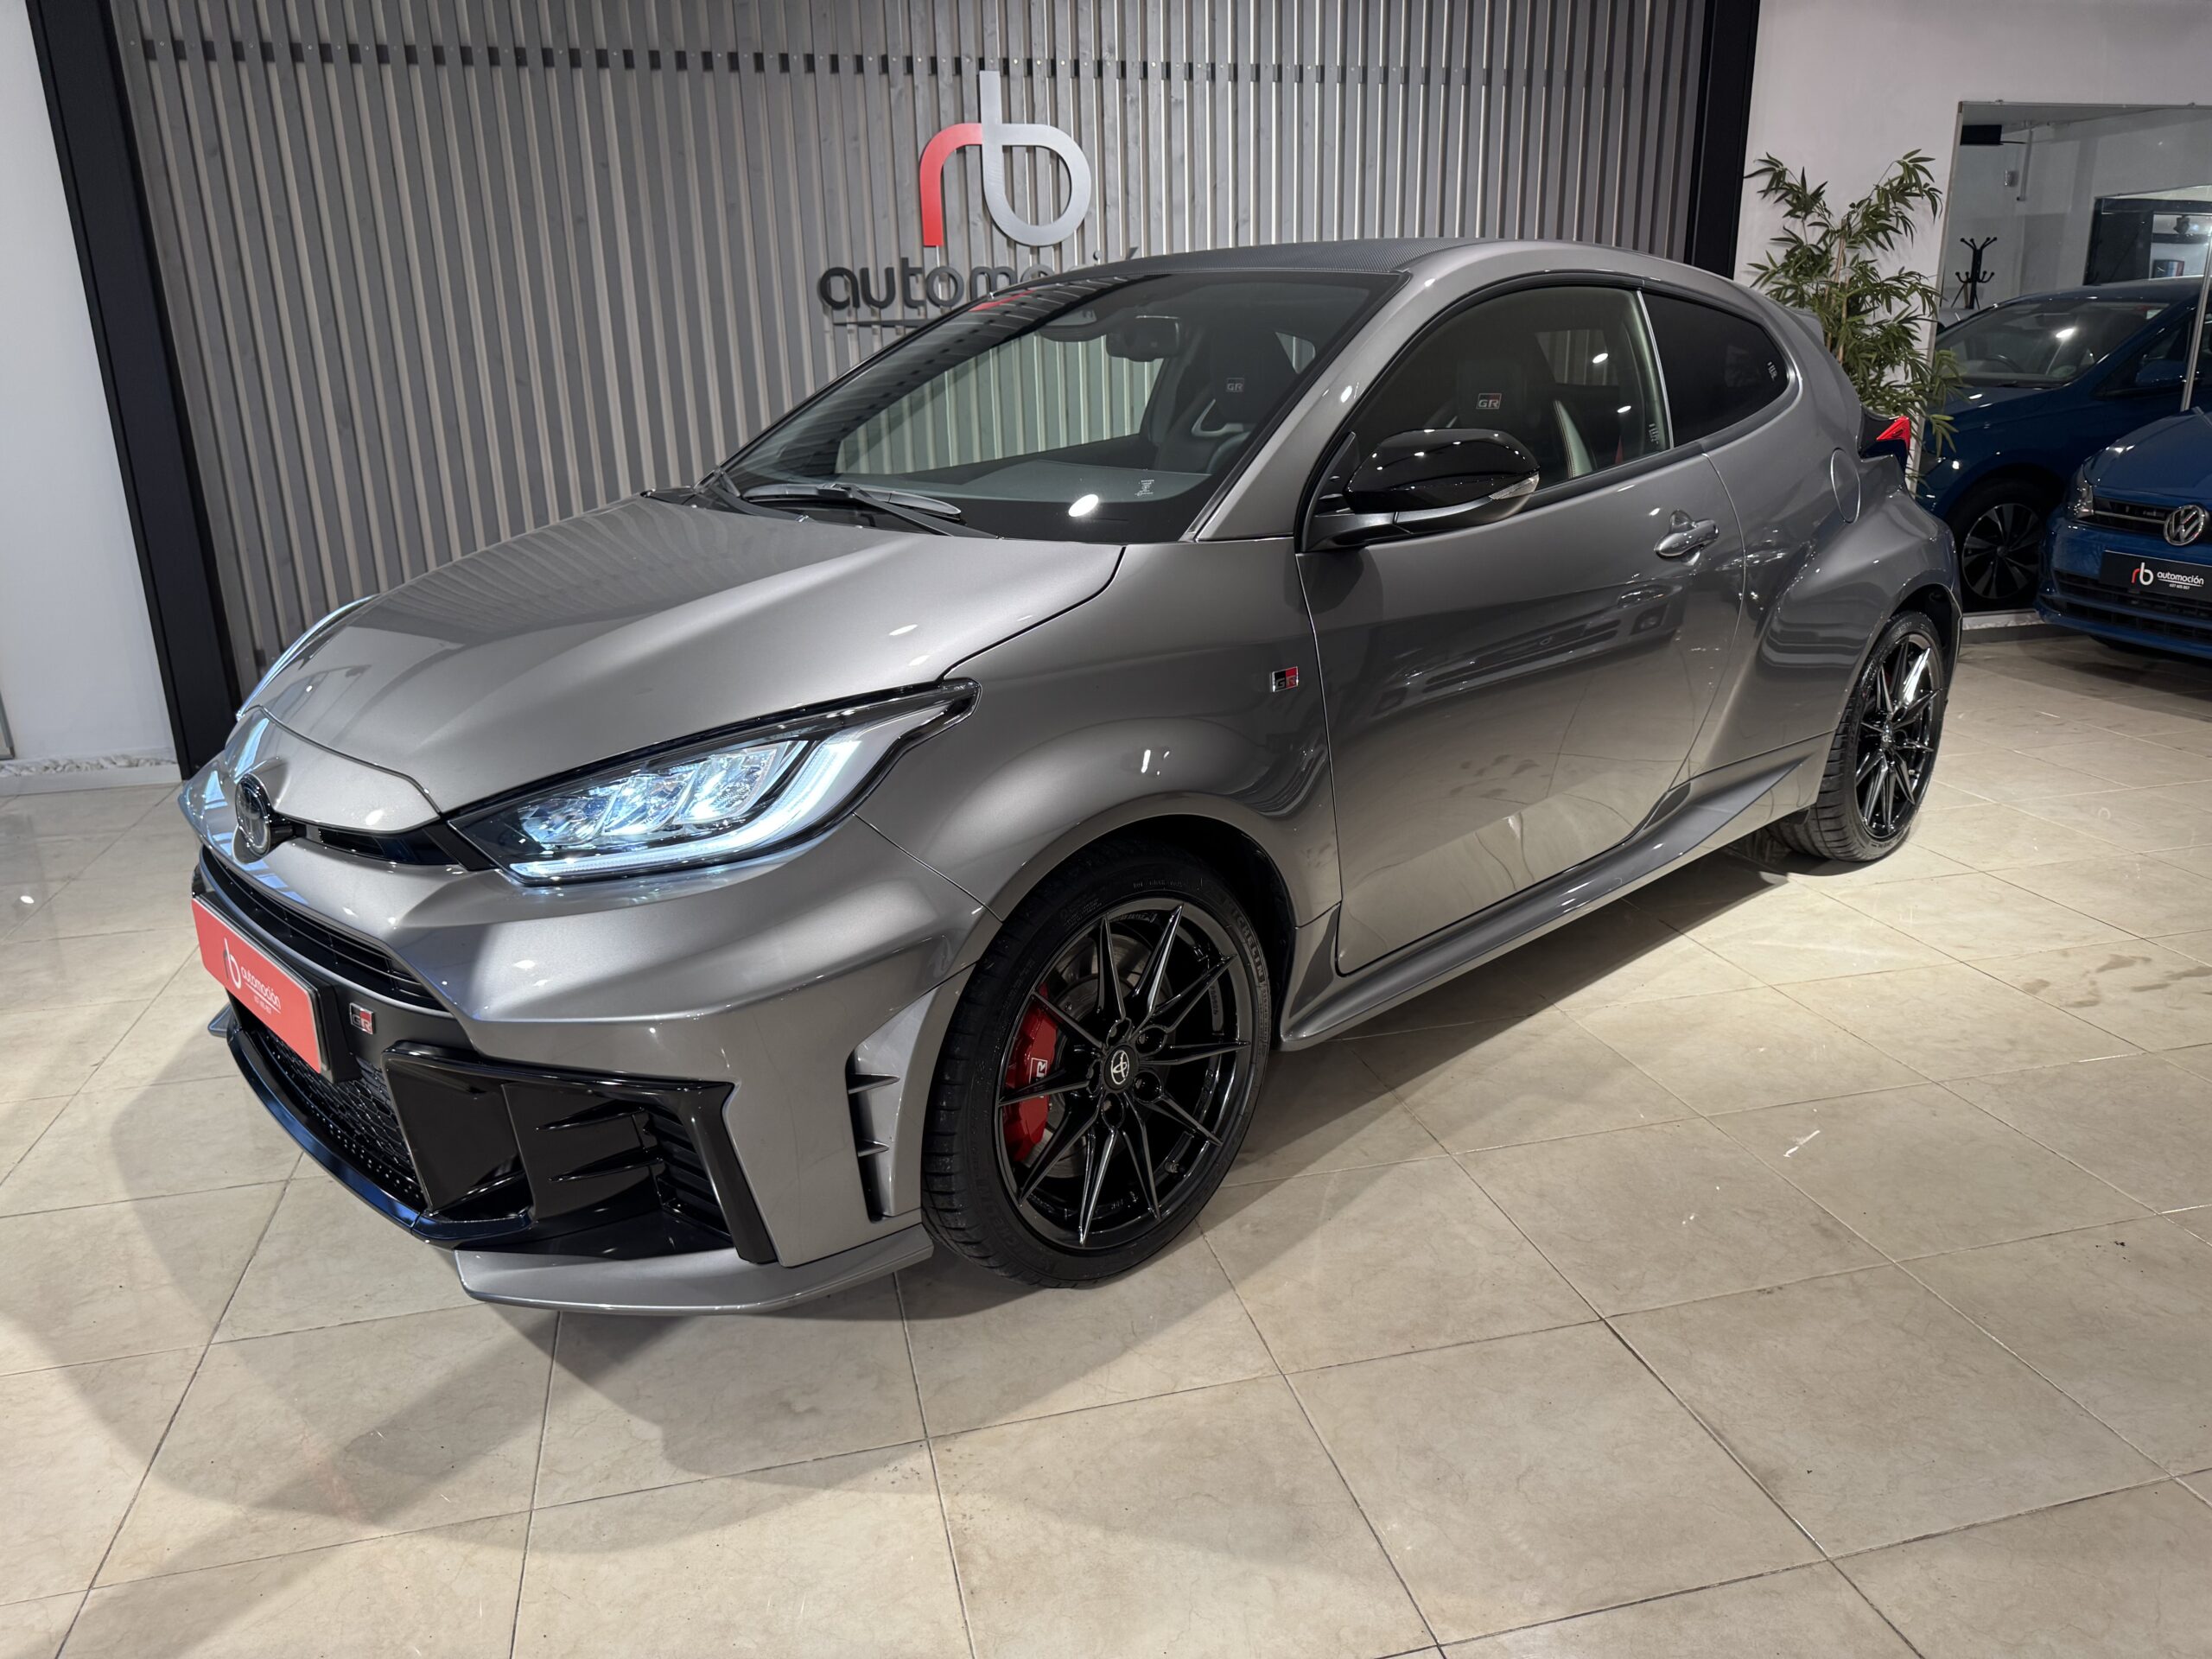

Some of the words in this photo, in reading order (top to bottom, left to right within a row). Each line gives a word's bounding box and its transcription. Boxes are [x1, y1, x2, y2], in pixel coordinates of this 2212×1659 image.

[919, 71, 1091, 246] rb
[1478, 399, 1499, 408] GR
[2131, 563, 2154, 586] rb
[2157, 571, 2204, 585] automoción
[1275, 675, 1296, 690] GR
[240, 966, 282, 1010] automoción
[352, 1014, 372, 1033] GR
